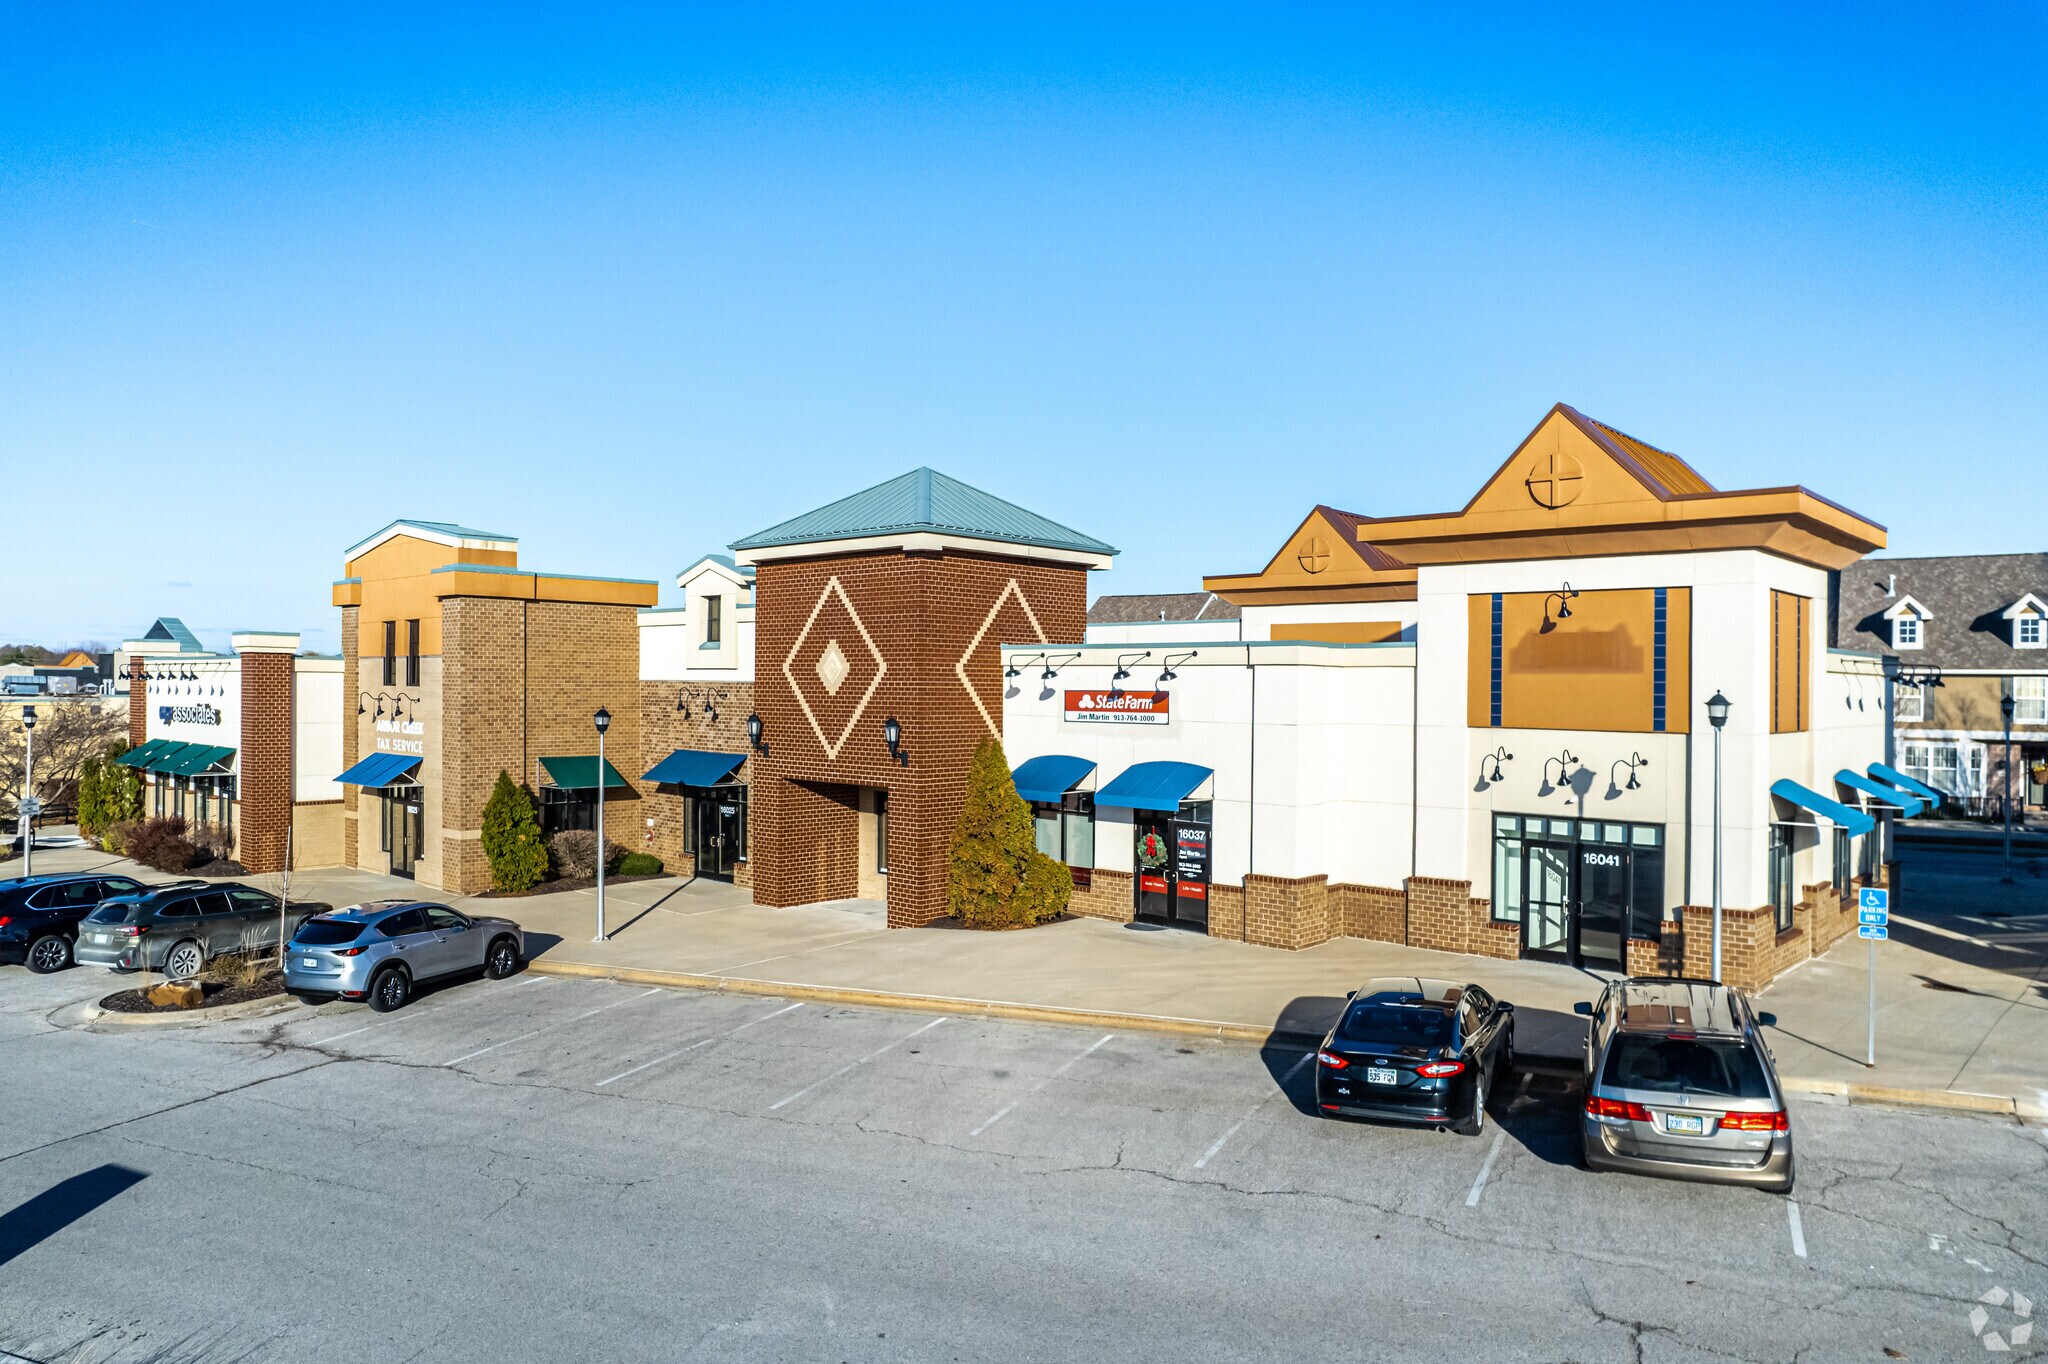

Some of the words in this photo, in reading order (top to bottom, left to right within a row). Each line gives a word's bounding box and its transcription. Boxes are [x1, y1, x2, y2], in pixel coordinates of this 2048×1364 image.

[172, 704, 216, 725] associates
[1089, 713, 1109, 721] Martin
[1113, 714, 1155, 722] 913-764-1000
[376, 719, 400, 733] ARBOR
[401, 721, 424, 735] CREEK
[377, 737, 390, 750] TAX
[392, 739, 423, 753] SERVICE
[1178, 828, 1206, 841] 16037
[1583, 853, 1620, 867] 16041
[1860, 906, 1887, 915] PARKING
[1865, 914, 1881, 922] ONLY
[1669, 1119, 1683, 1129] 230
